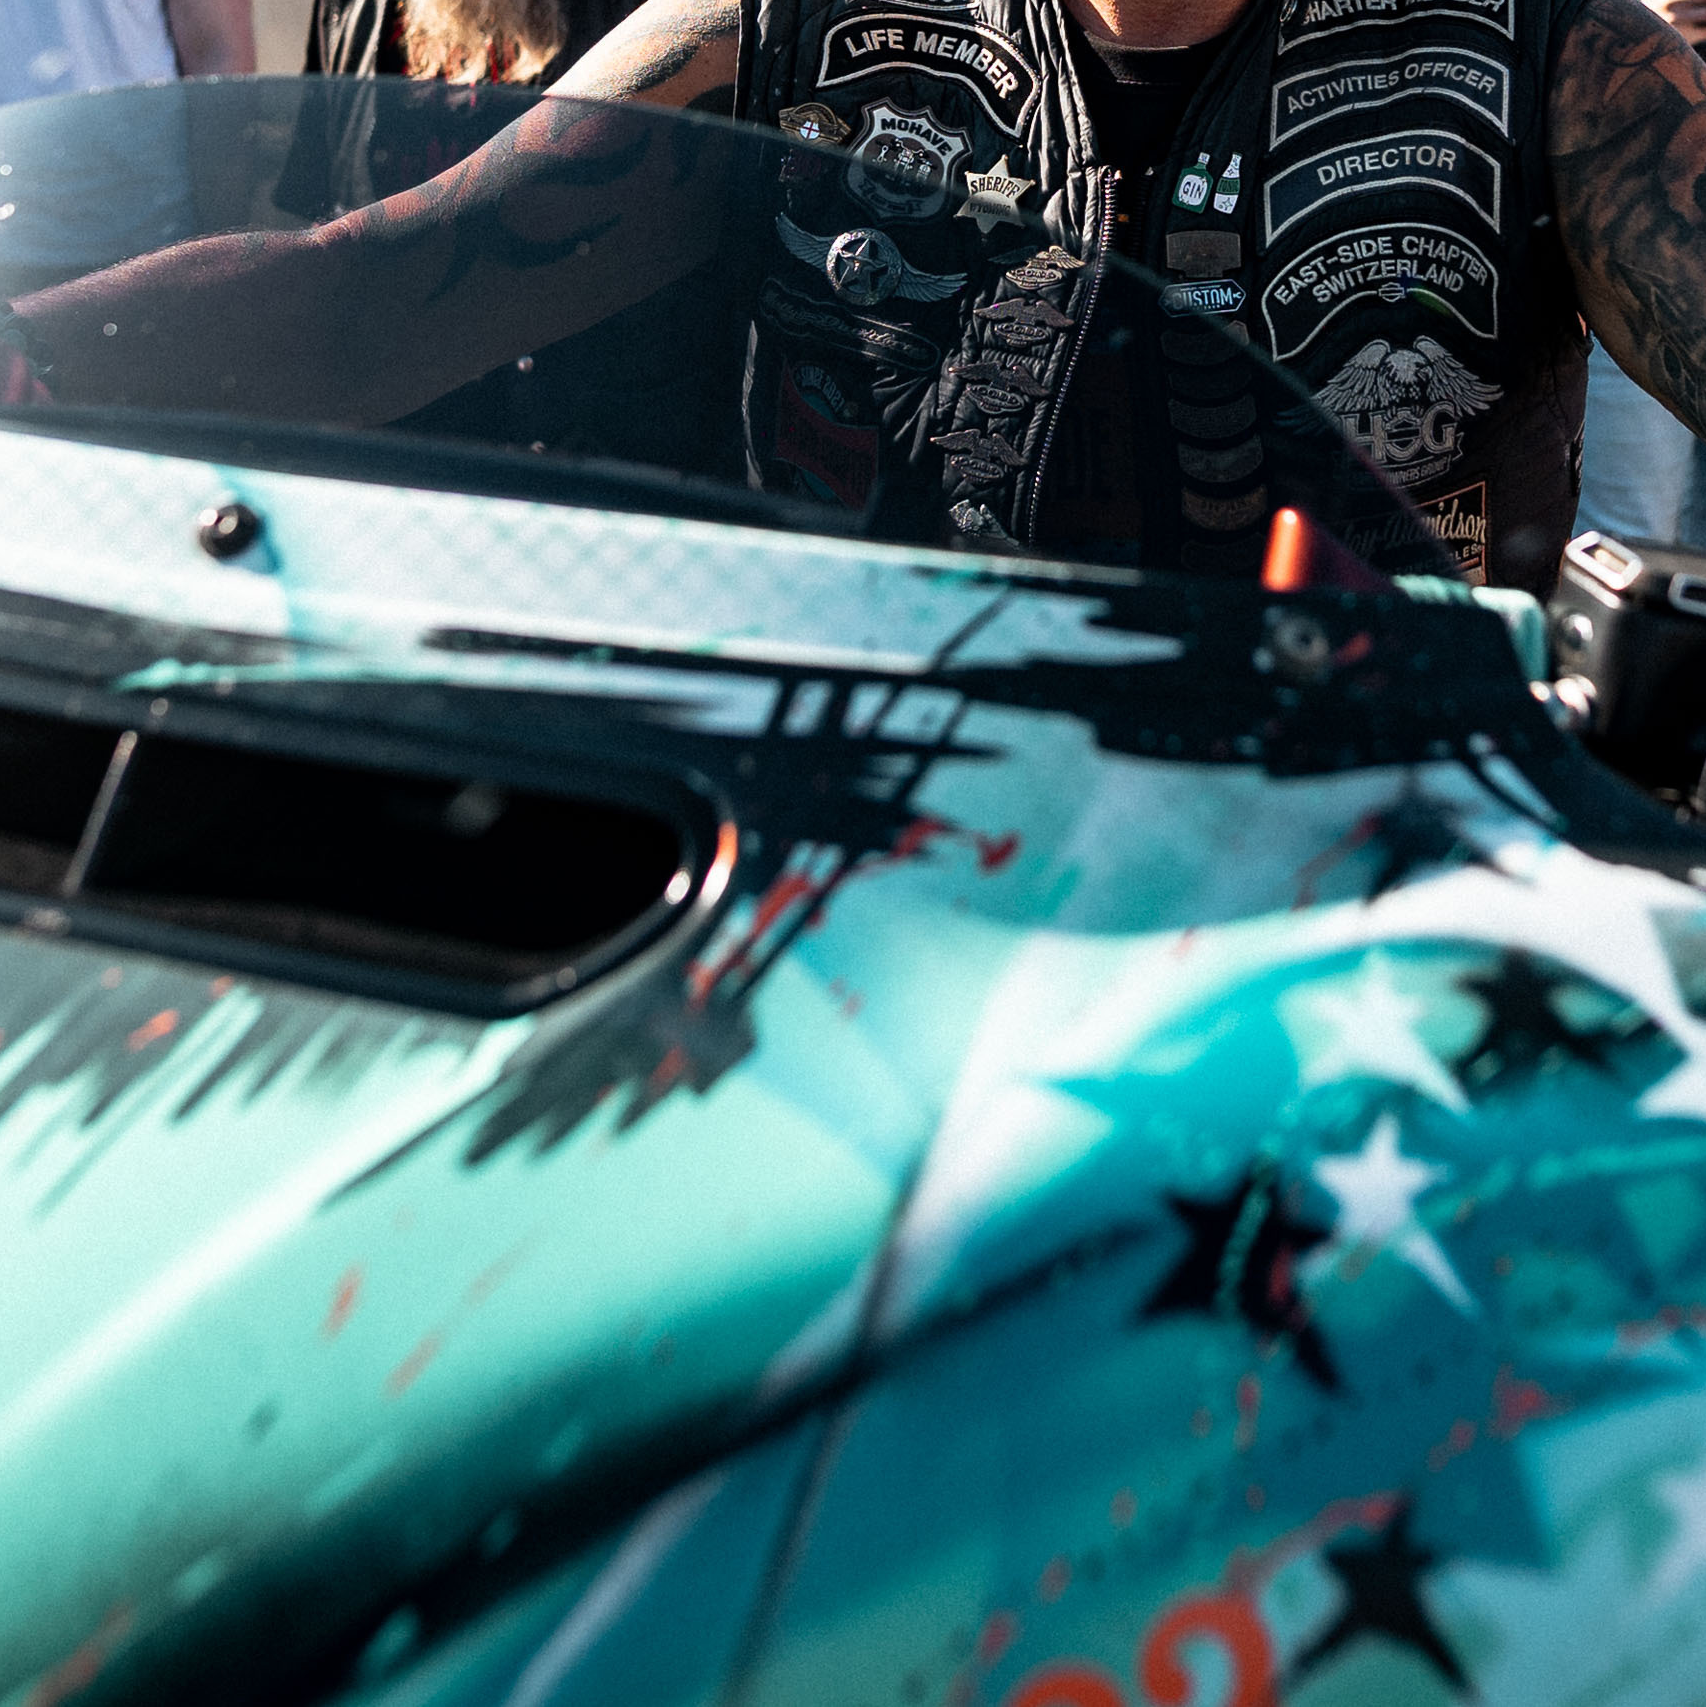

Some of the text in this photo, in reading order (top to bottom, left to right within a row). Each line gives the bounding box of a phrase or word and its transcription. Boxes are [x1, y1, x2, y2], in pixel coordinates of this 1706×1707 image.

[844, 29, 1019, 100] LIFE MEMBER
[1287, 62, 1497, 114] ACTIVITIES OFFICER
[880, 117, 950, 156] MOHAVE
[970, 175, 1021, 199] SHERIFF
[1317, 145, 1457, 186] DIRECTOR
[1182, 180, 1204, 199] GIN
[1273, 235, 1394, 306] EAST-SIDE
[1401, 235, 1489, 287] CHAPTER
[1312, 259, 1465, 304] SWITZERLAND
[1172, 286, 1235, 311] CUSTOM
[1340, 400, 1460, 464] HOG
